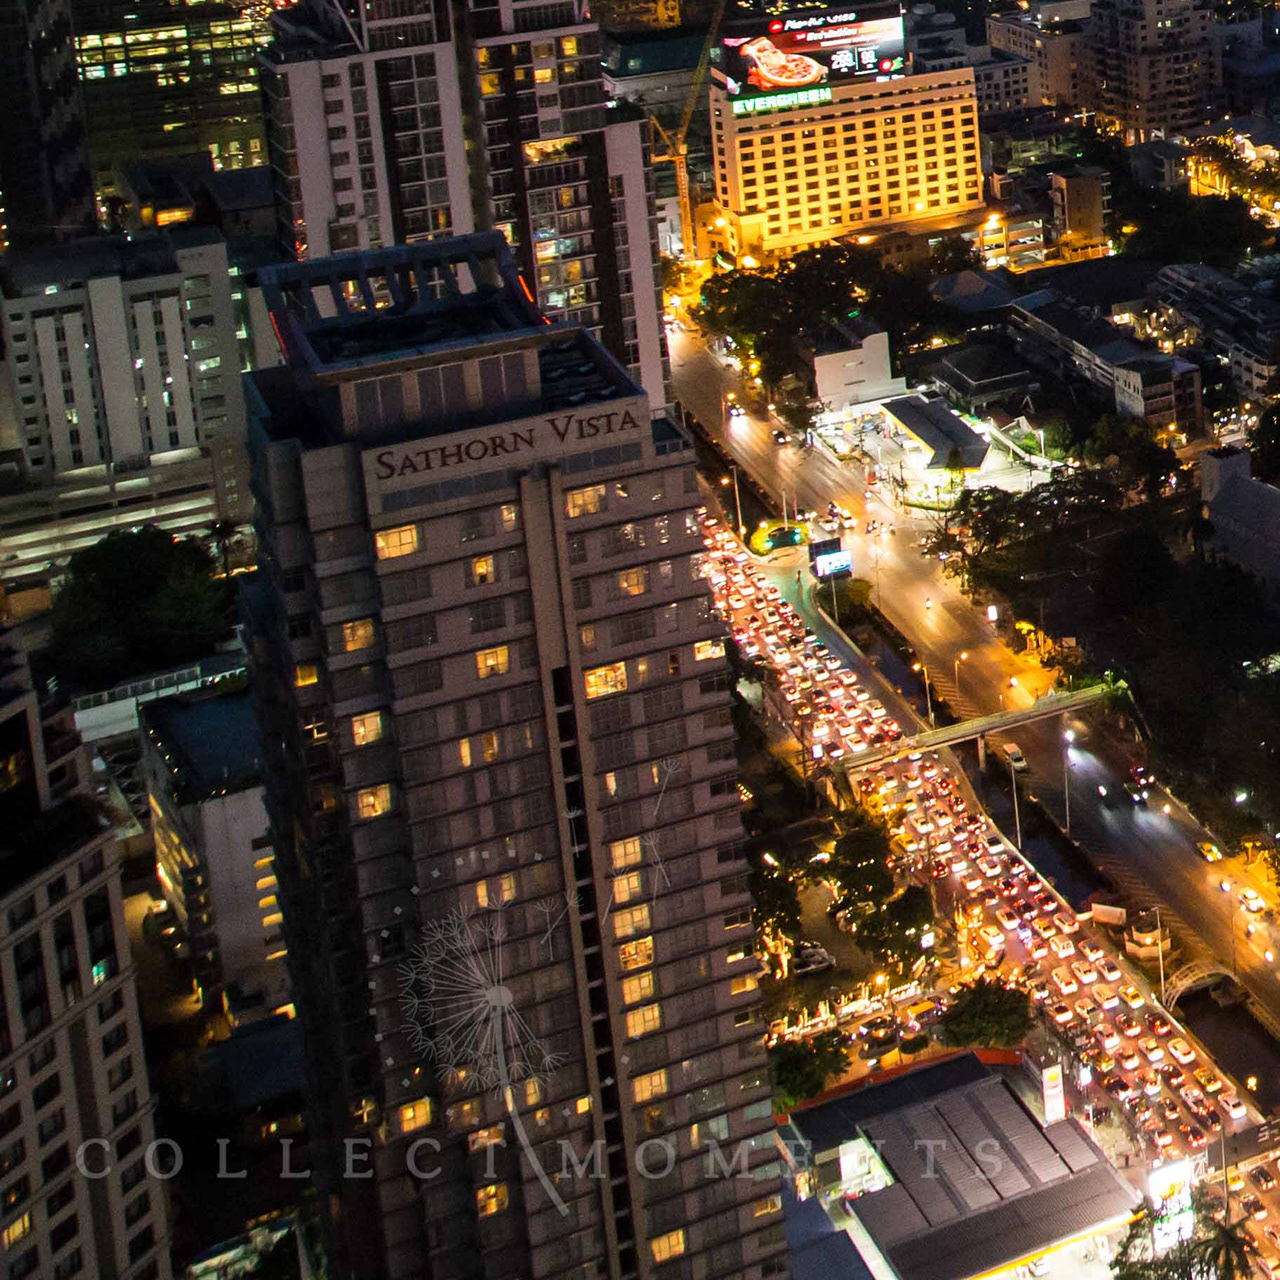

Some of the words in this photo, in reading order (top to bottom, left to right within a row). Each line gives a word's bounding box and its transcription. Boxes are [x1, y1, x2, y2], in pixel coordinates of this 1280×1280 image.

[732, 87, 832, 114] EVERGREEN
[375, 428, 535, 480] SATHORN
[546, 409, 641, 443] VISTA
